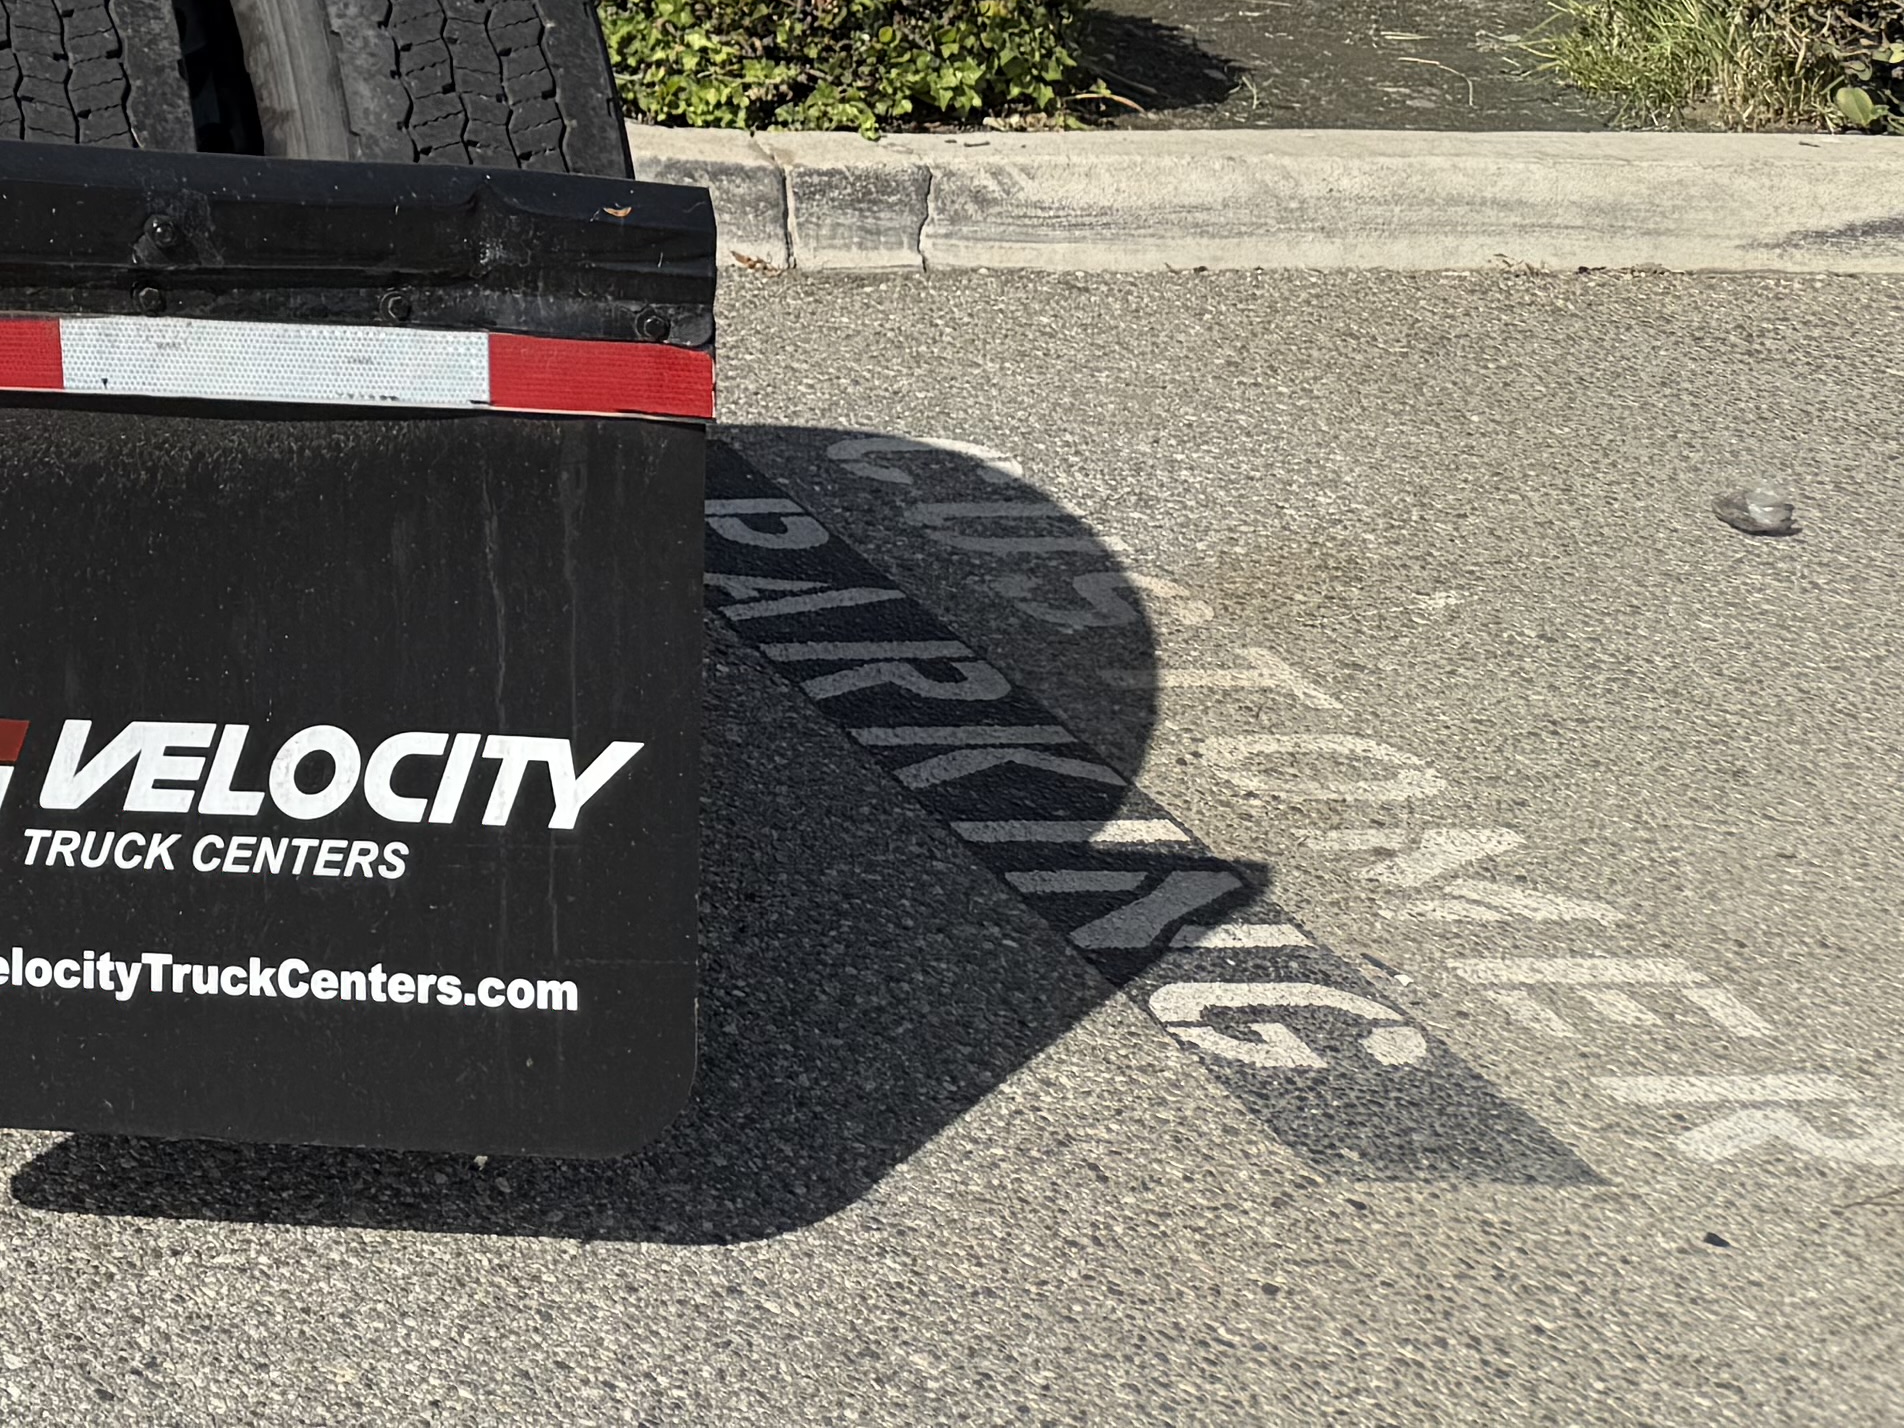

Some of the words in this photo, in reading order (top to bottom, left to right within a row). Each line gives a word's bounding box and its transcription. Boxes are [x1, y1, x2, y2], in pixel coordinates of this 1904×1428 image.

[22, 828, 183, 872] TRUCK
[191, 833, 411, 881] CENTERS
[38, 718, 646, 830] VELOCITY
[704, 497, 1429, 1068] PARKING
[826, 436, 1904, 1166] CUSTOMER
